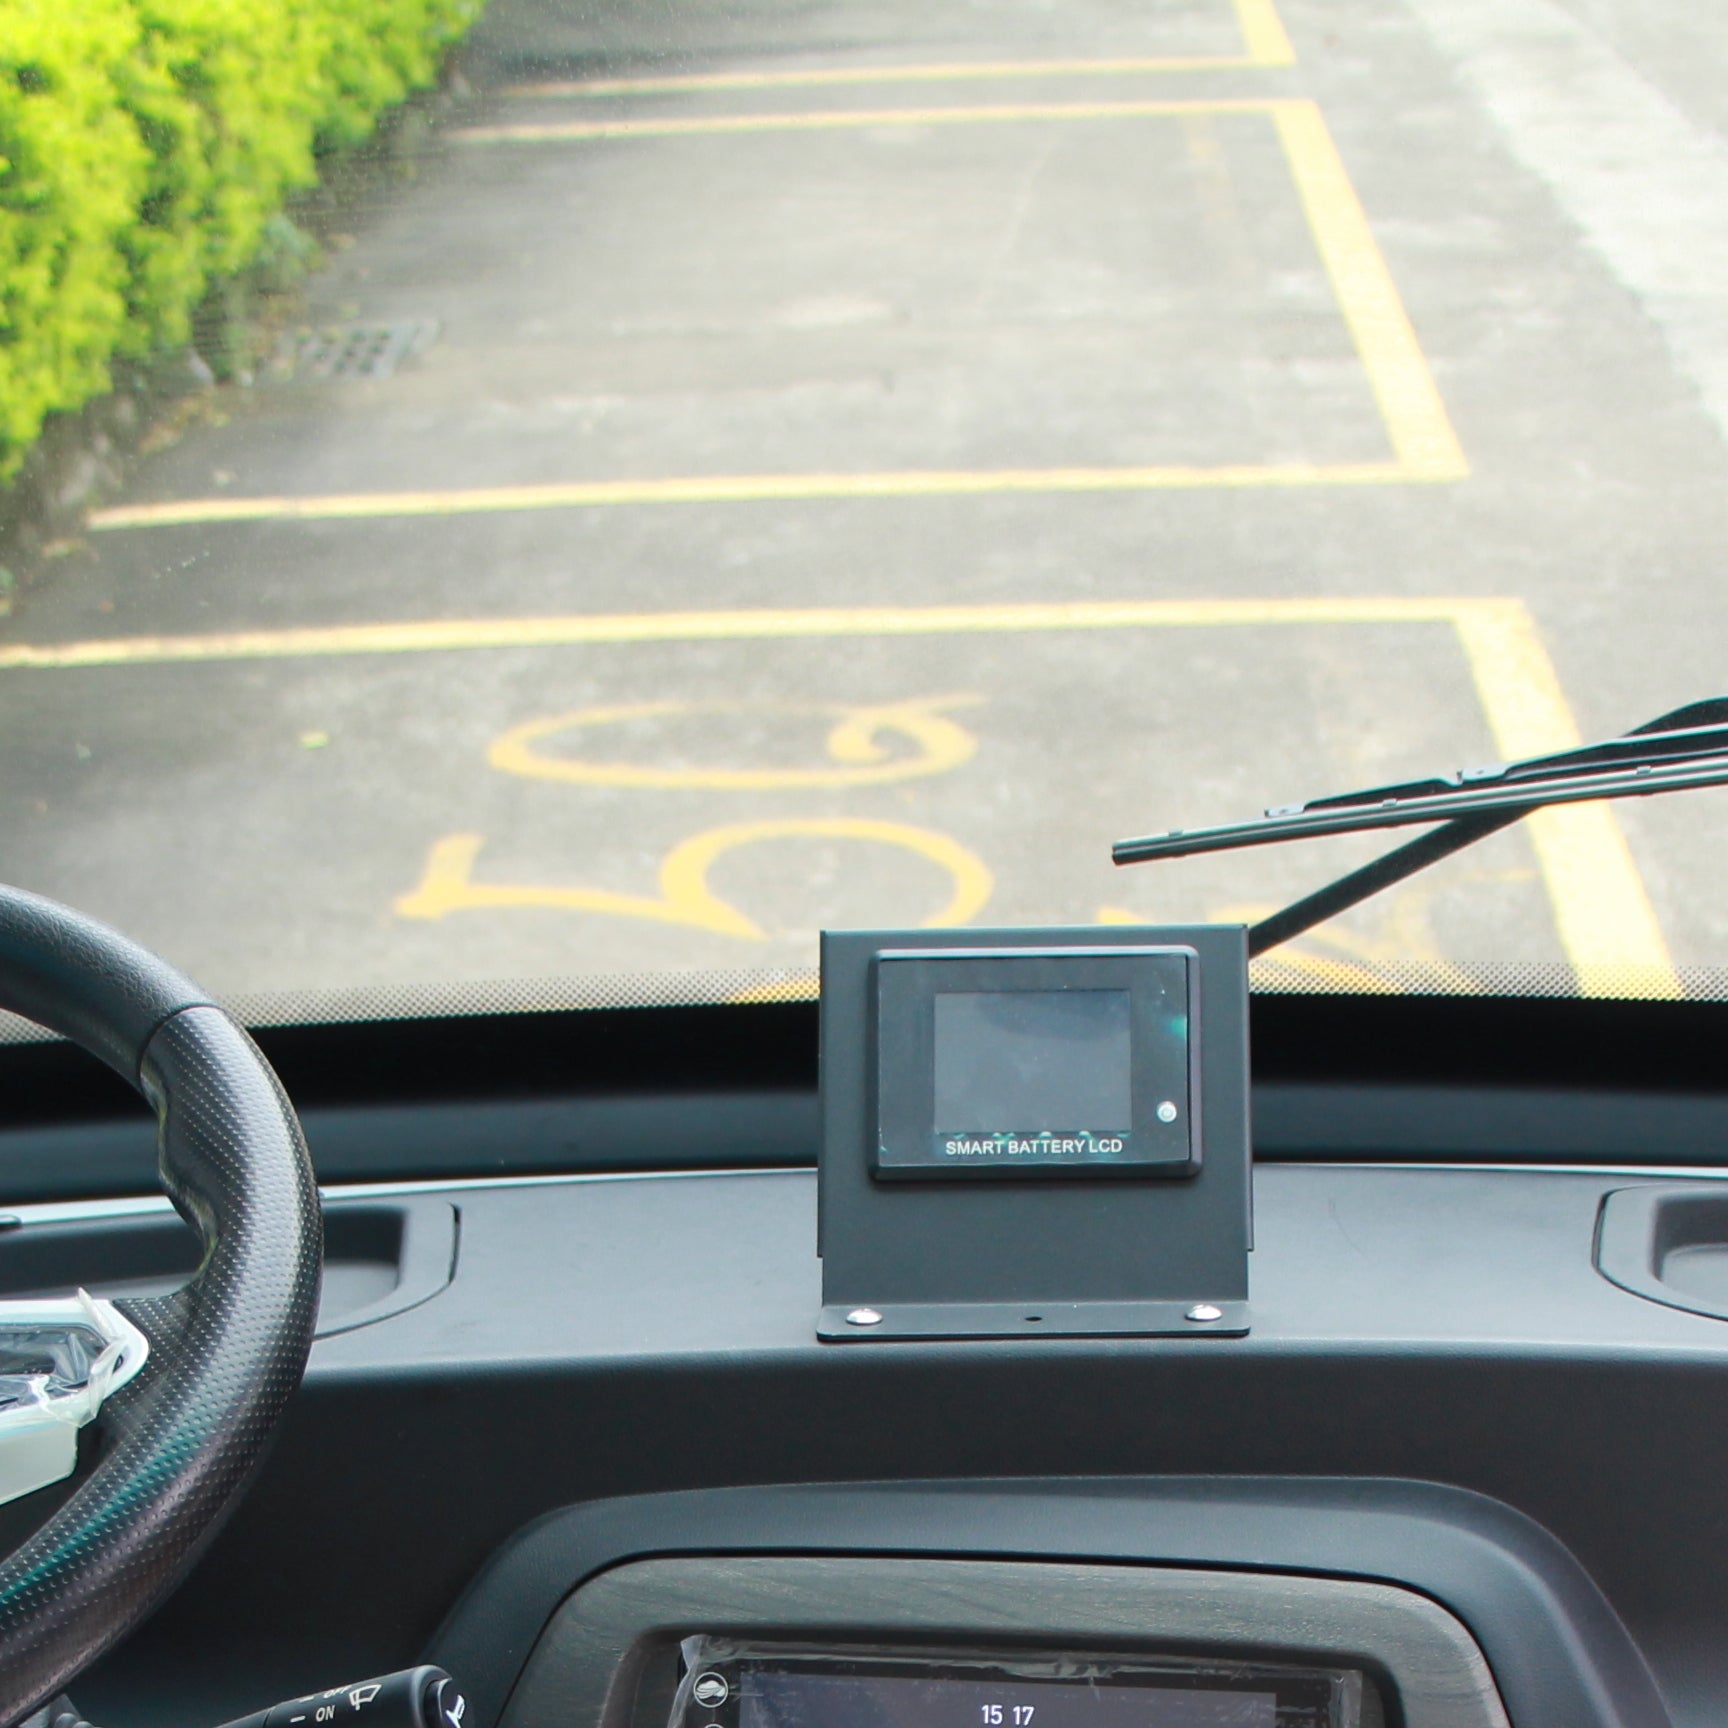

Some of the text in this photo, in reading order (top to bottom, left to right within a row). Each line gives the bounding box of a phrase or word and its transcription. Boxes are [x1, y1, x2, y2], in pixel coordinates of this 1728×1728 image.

[945, 1138, 1123, 1156] SMART BATTERY LCD
[315, 1704, 336, 1722] ON
[981, 1704, 1035, 1726] 15 17
